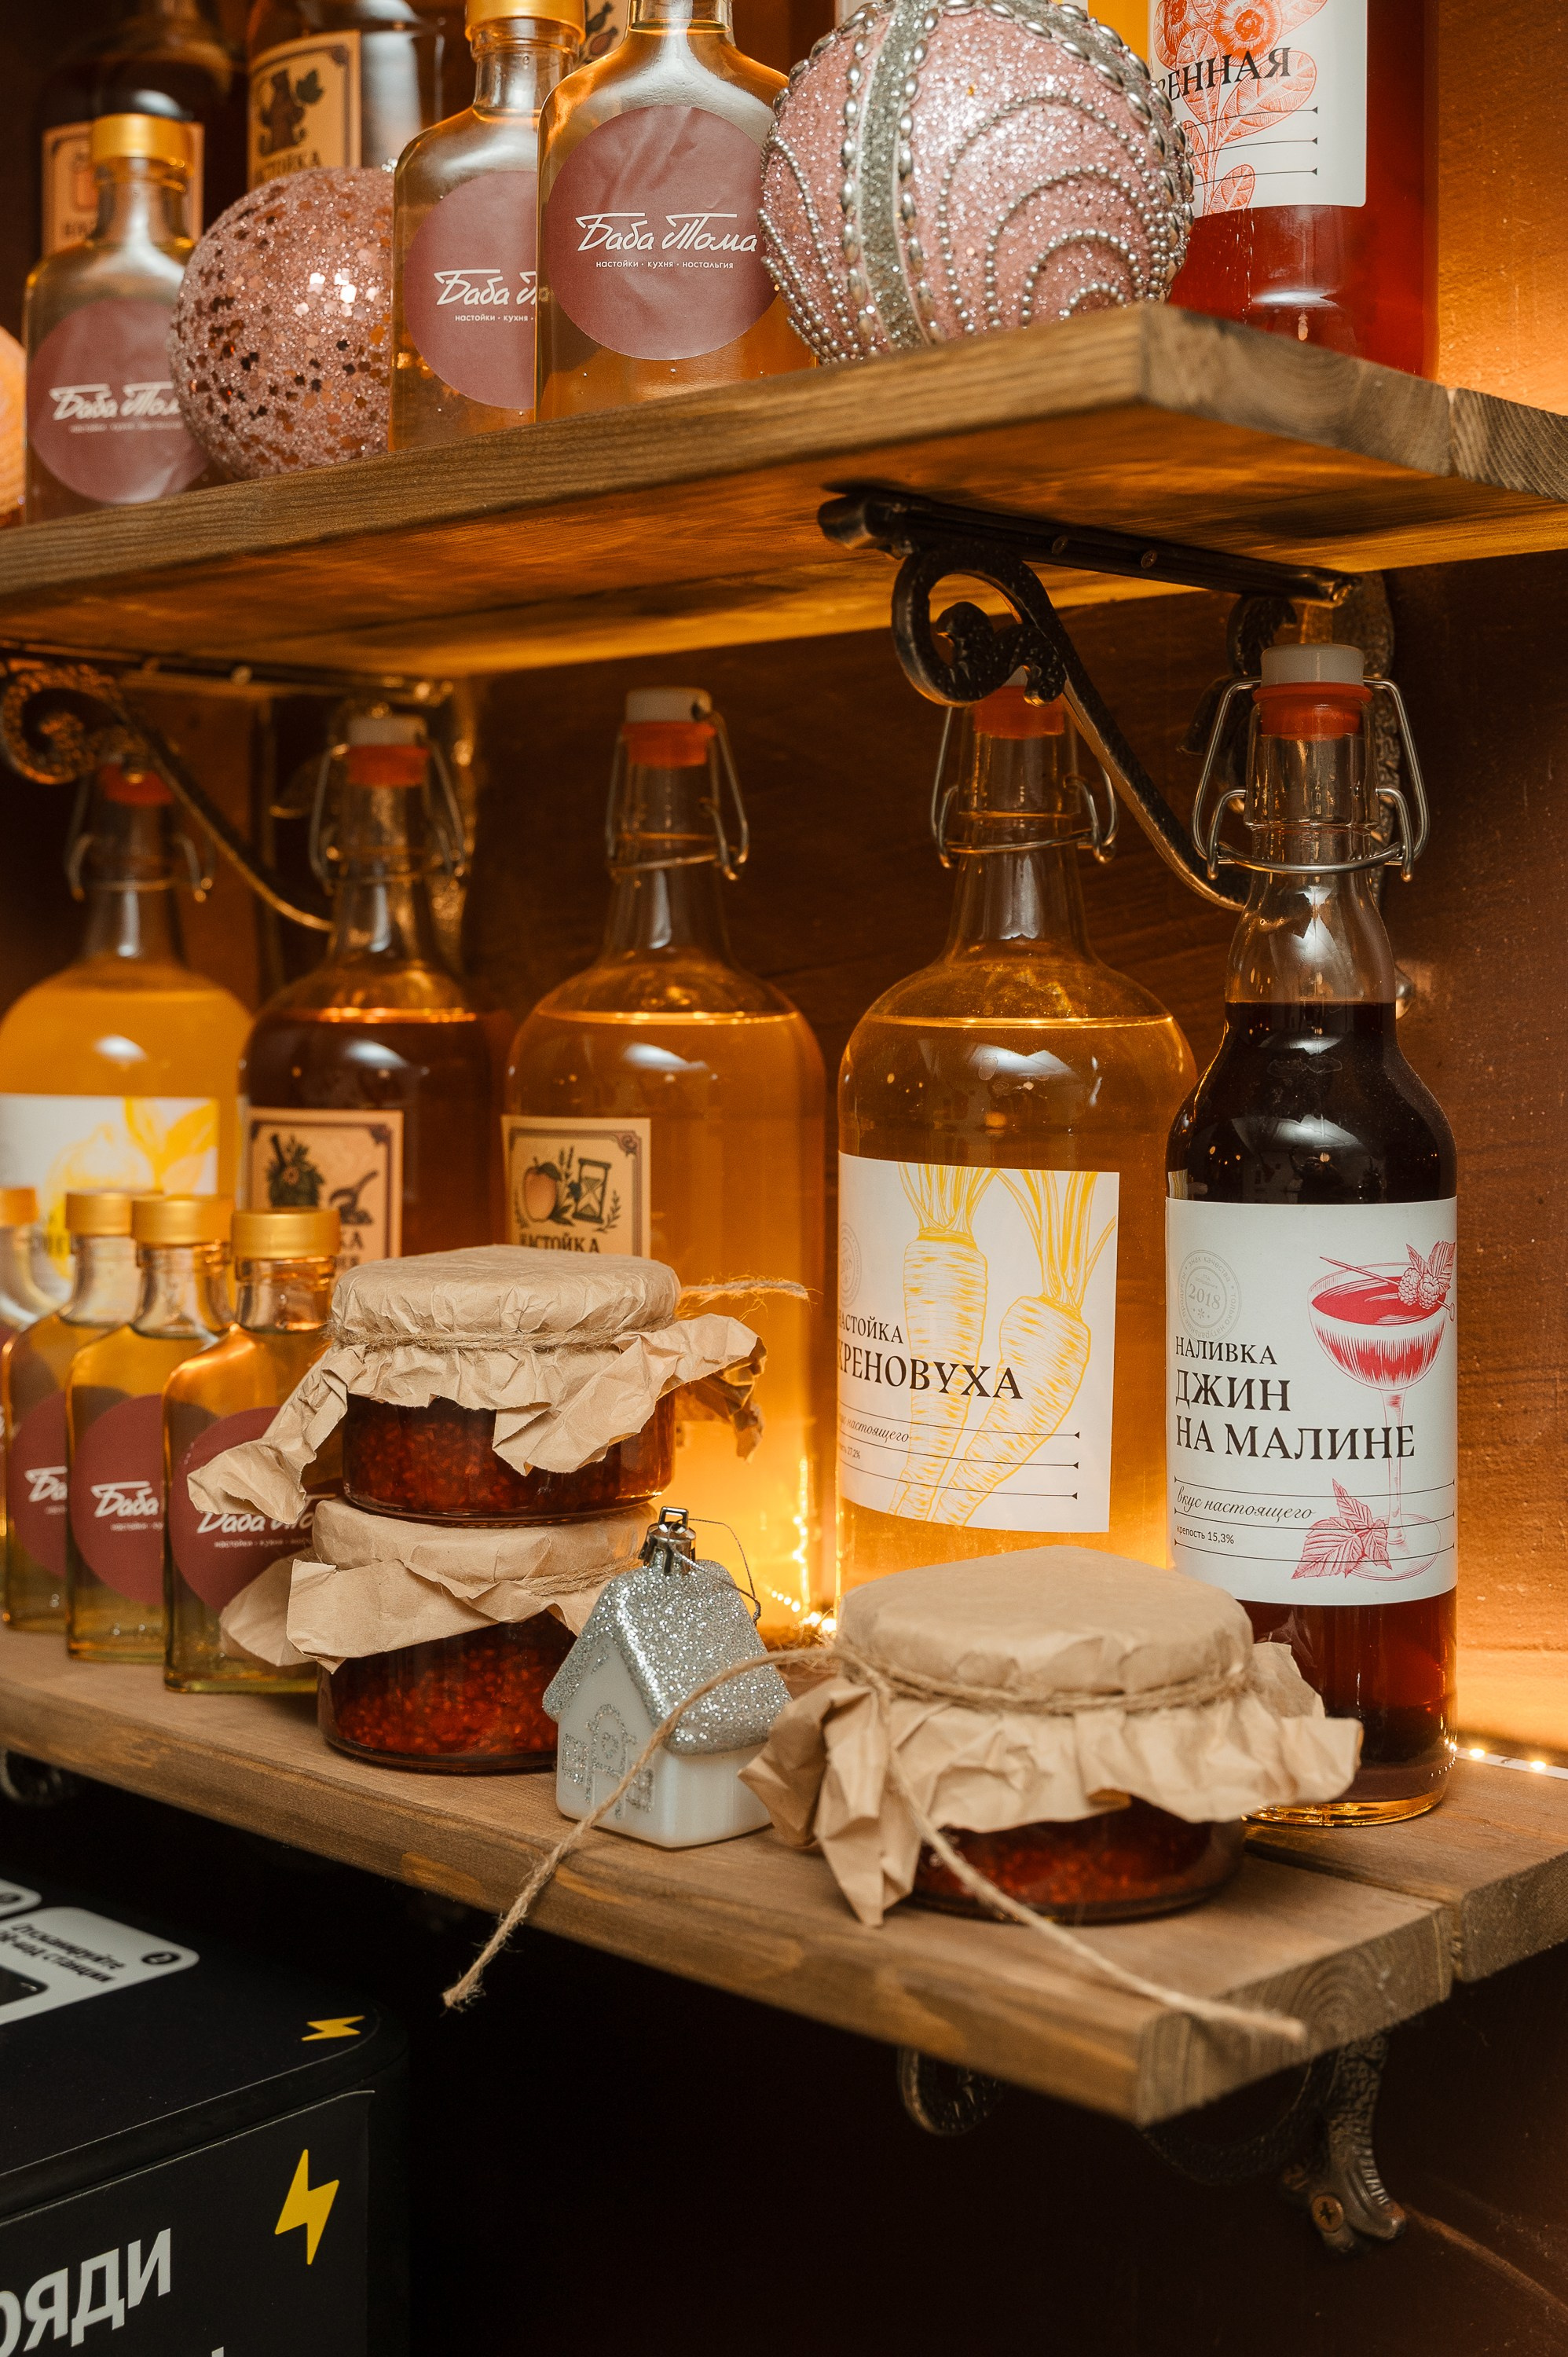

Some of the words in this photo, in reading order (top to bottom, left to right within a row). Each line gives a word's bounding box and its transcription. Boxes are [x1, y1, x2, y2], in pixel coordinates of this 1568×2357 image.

[575, 212, 654, 251] Баба
[661, 213, 757, 252] Тома
[595, 260, 639, 269] настойки
[647, 261, 673, 269] кухня
[434, 269, 510, 305] Баба
[504, 314, 529, 323] кухня
[1189, 1283, 1221, 1310] 2018
[1175, 1336, 1277, 1365] НАЛИВКА
[1175, 1369, 1291, 1411] ДЖИН
[848, 1417, 910, 1443] настоящего
[1176, 1414, 1215, 1453] НА
[1224, 1424, 1415, 1461] МАЛИНЕ
[90, 1480, 159, 1518] Баба
[1177, 1486, 1203, 1512] вкус
[1203, 1499, 1317, 1523] настоящего
[1176, 1525, 1206, 1540] крепость
[1207, 1531, 1235, 1545] 15,3%
